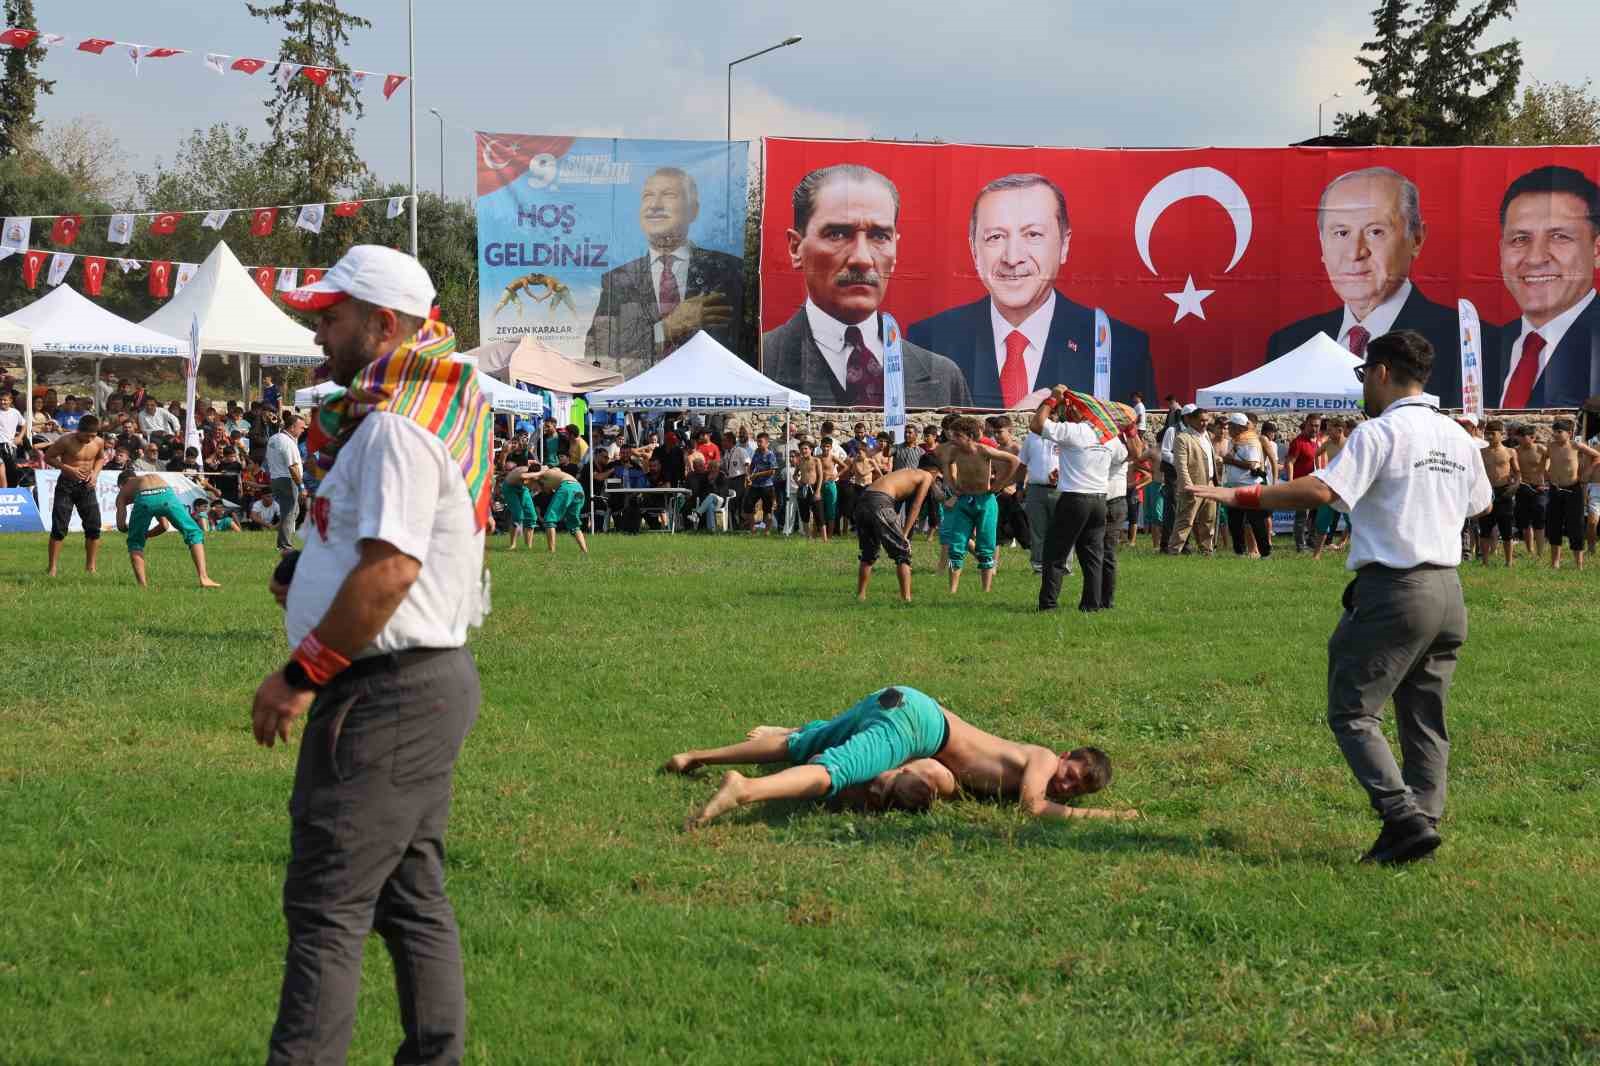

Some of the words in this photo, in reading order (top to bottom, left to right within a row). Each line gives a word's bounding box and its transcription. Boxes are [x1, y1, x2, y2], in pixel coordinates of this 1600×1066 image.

[517, 203, 576, 233] HOŞ
[484, 236, 609, 267] GELDİNİZ
[496, 325, 530, 335] ZEYDAN
[532, 325, 572, 335] KARALAR
[606, 398, 630, 408] T.C.
[634, 397, 682, 408] KOZAN
[688, 394, 770, 408] BELEDİYESİ
[1213, 396, 1238, 407] T.C.
[1242, 397, 1291, 408] KOZAN
[1296, 396, 1358, 409] BELEDİY
